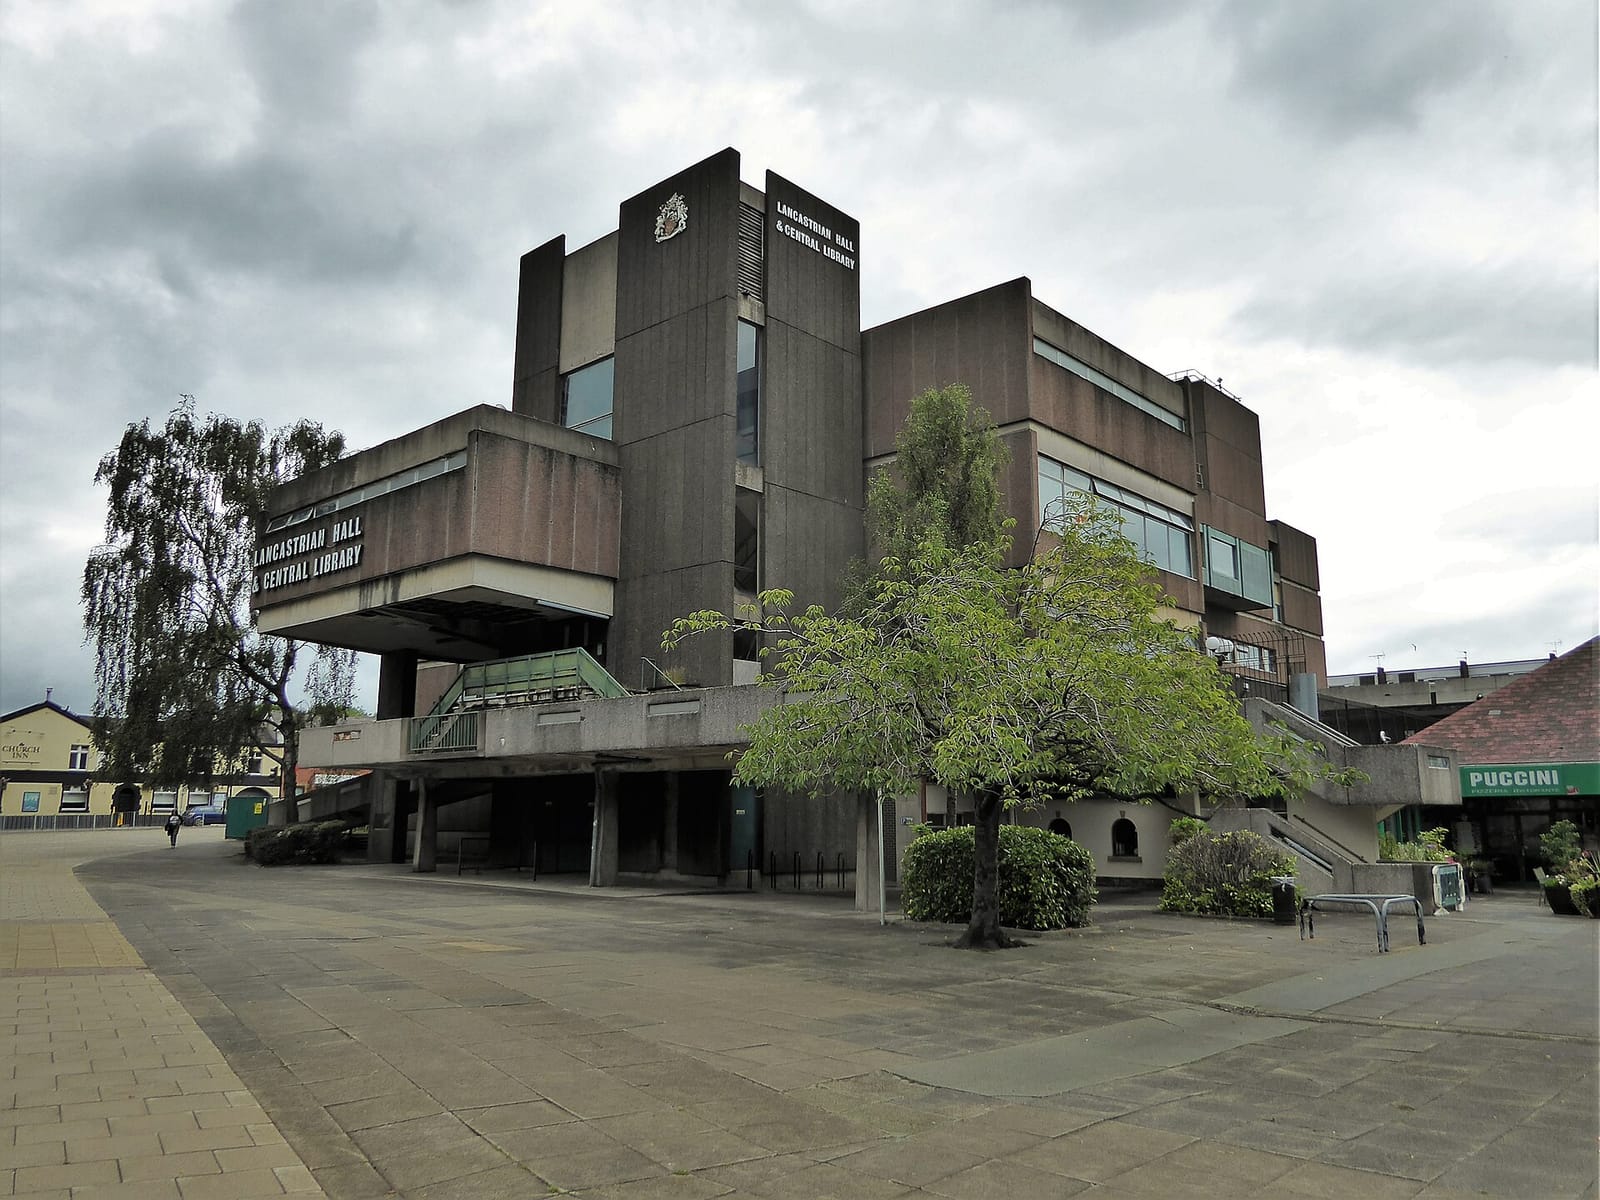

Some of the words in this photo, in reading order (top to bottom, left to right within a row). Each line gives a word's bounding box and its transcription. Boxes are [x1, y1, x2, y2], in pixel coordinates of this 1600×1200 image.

[776, 219, 783, 232] &
[784, 224, 820, 252] CENTRAL
[823, 244, 855, 270] LIBRARY
[777, 201, 831, 240] LANCASTRIAN
[835, 233, 854, 252] HALL
[254, 528, 325, 568] LANCASTRIAN
[332, 516, 361, 543] HALL
[252, 575, 259, 594] &
[263, 560, 308, 590] CENTRAL
[313, 544, 362, 577] LIBRARY
[2, 745, 40, 753] CHURCH
[1469, 769, 1559, 787] PUCCINI
